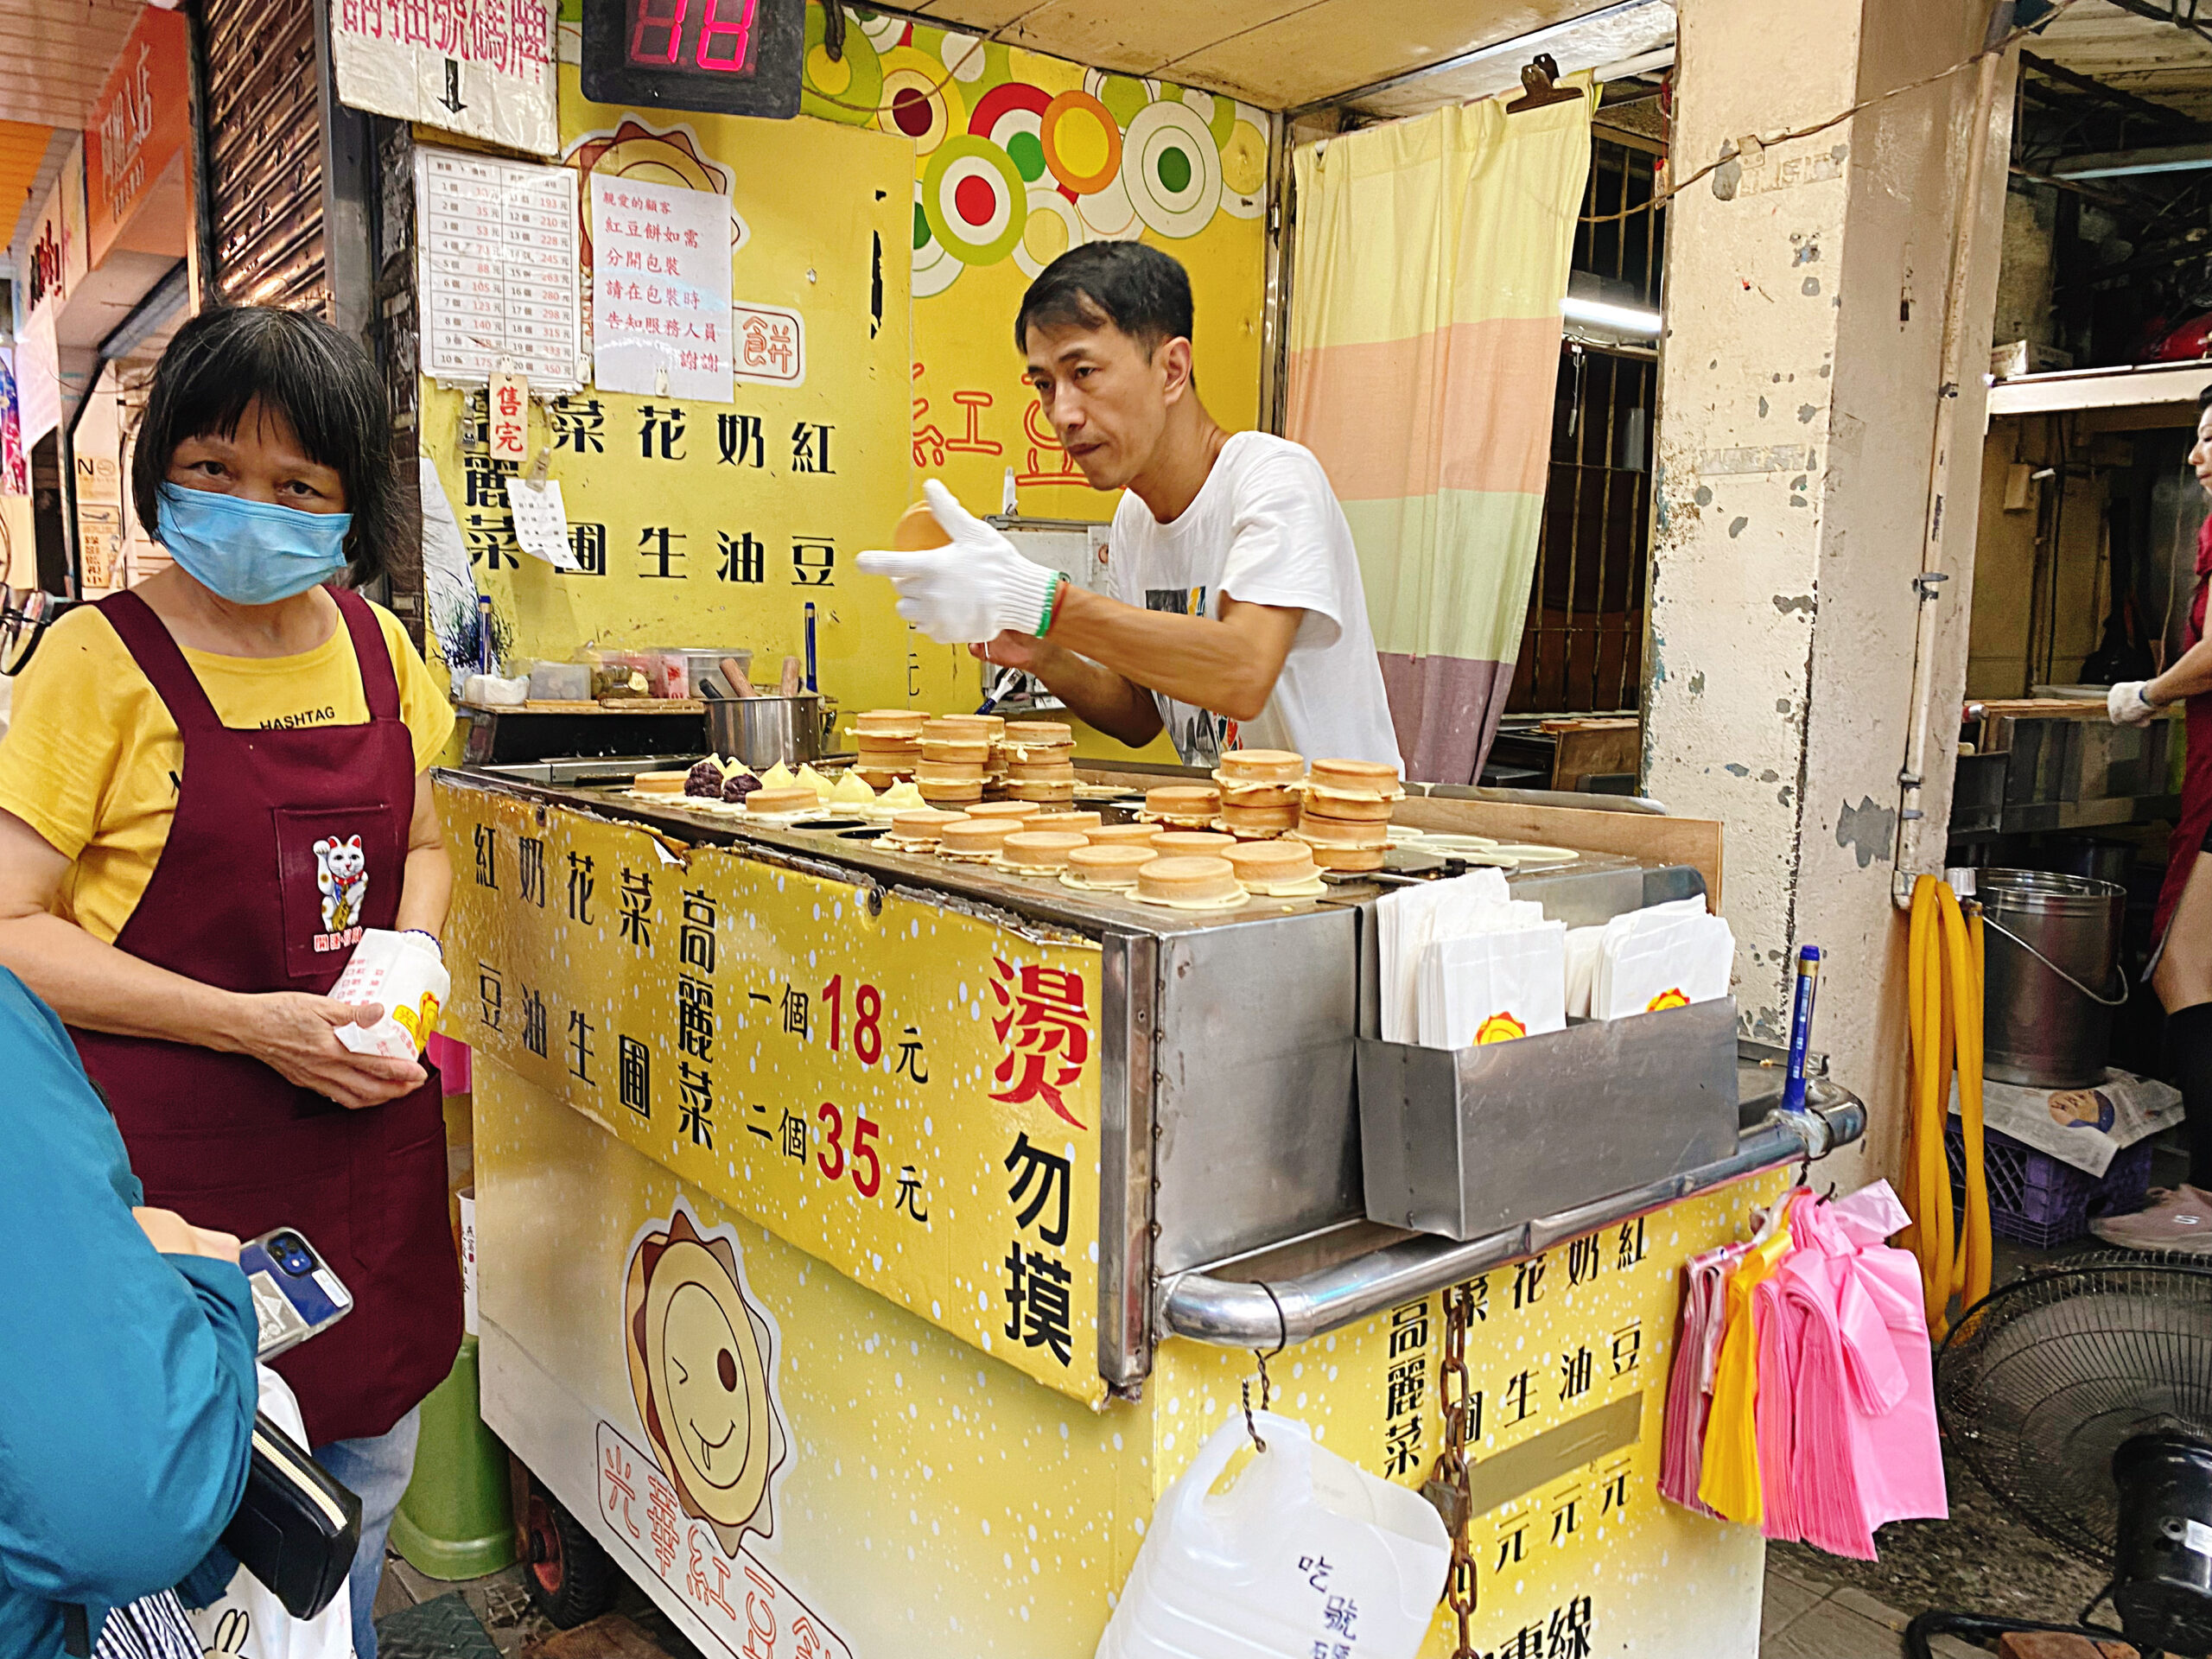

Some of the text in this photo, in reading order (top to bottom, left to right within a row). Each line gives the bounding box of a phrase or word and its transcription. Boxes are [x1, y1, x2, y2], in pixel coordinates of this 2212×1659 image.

[602, 191, 671, 213] 親愛的顧客
[605, 217, 699, 249] 紅豆餅如需
[607, 247, 681, 276] 分開包裝
[605, 311, 717, 343] 告知服務人員
[606, 280, 700, 310] 請在包裝時
[680, 350, 719, 373] 謝謝
[495, 385, 524, 452] 售完
[259, 706, 335, 730] HASHTAG
[474, 823, 504, 1034] 紅豆
[518, 836, 548, 1061] 奶油
[566, 851, 596, 1088] 花生
[618, 868, 654, 1121] 菜圃
[677, 888, 717, 1151] 高麗菜
[988, 955, 1090, 1369] 燙勿摸
[1383, 1296, 1430, 1479] 高麗菜
[1503, 1252, 1548, 1428] 花生
[1558, 1232, 1599, 1403] 奶油
